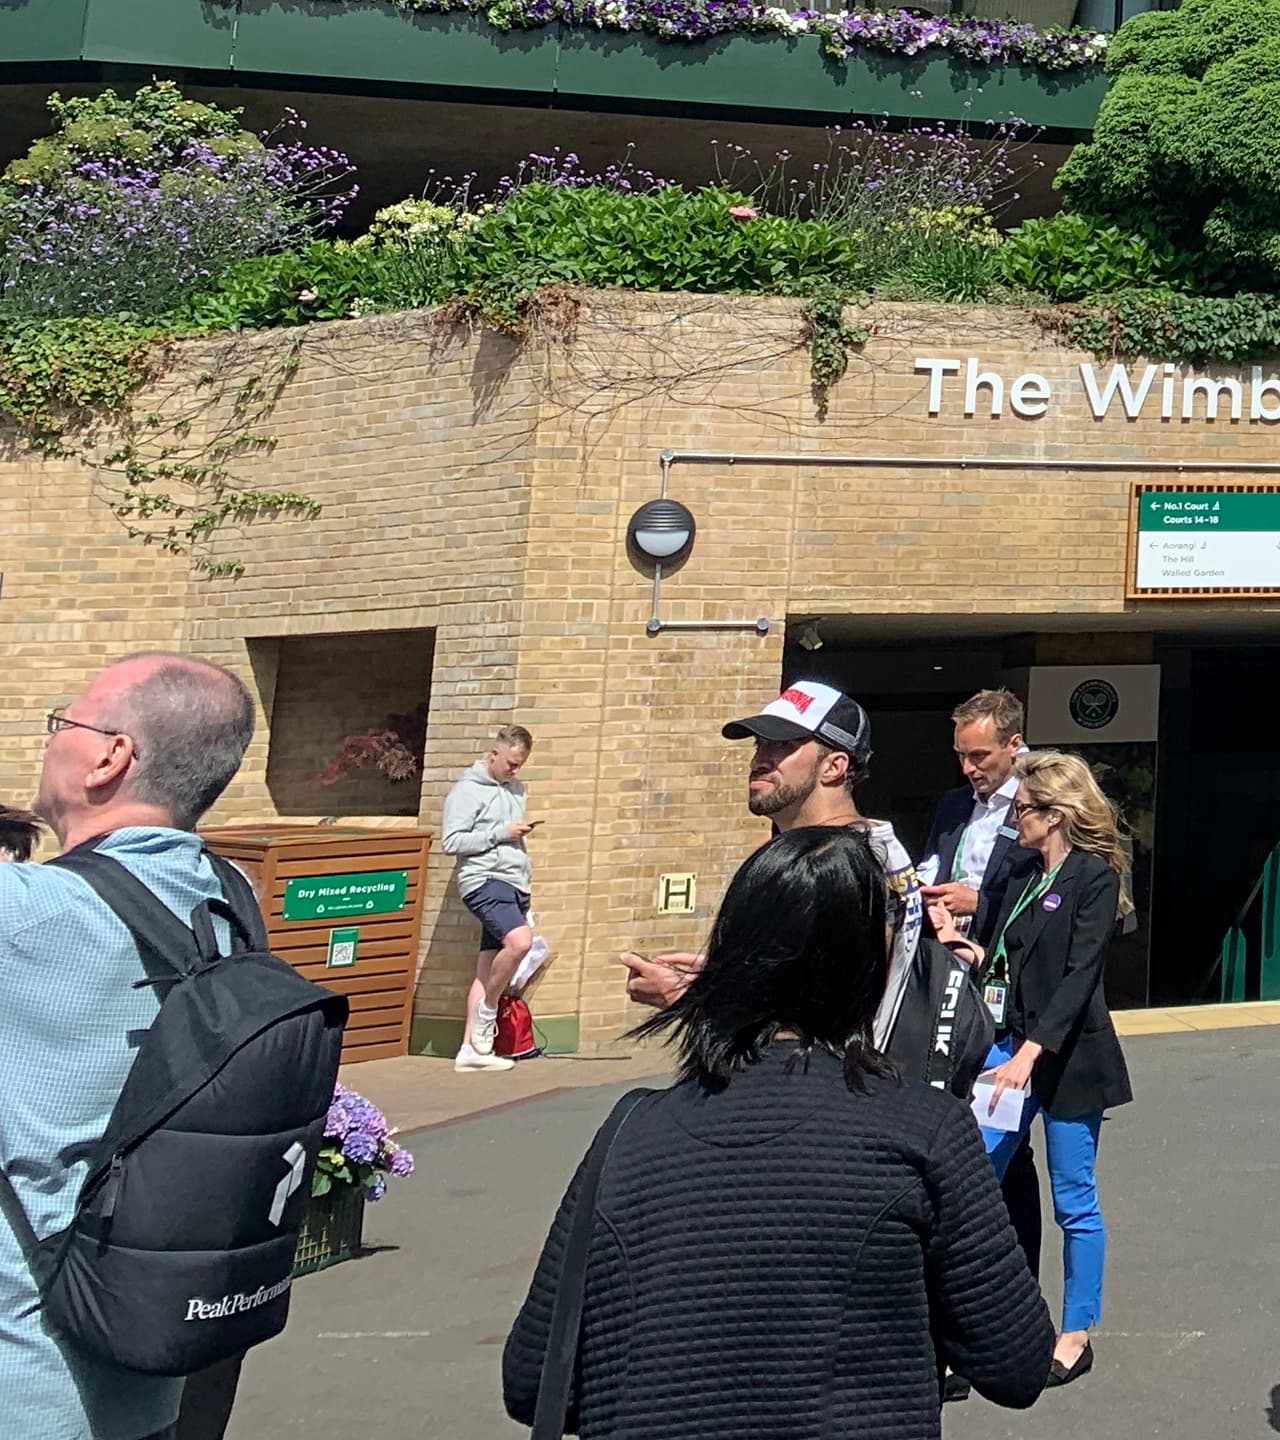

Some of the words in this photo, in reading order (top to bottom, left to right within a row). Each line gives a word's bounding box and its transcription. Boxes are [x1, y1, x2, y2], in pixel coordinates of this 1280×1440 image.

[915, 358, 1051, 417] The
[1164, 502, 1183, 511] No.1
[1184, 502, 1209, 511] Court
[1163, 515, 1193, 524] Courts
[1163, 542, 1196, 550] Aorangi
[1163, 555, 1178, 563] The
[1180, 555, 1195, 563] Hill
[1193, 569, 1225, 577] Garden
[298, 890, 315, 898] Dry
[318, 886, 347, 896] Mixed
[350, 883, 395, 894] Recycling
[663, 878, 691, 910] H
